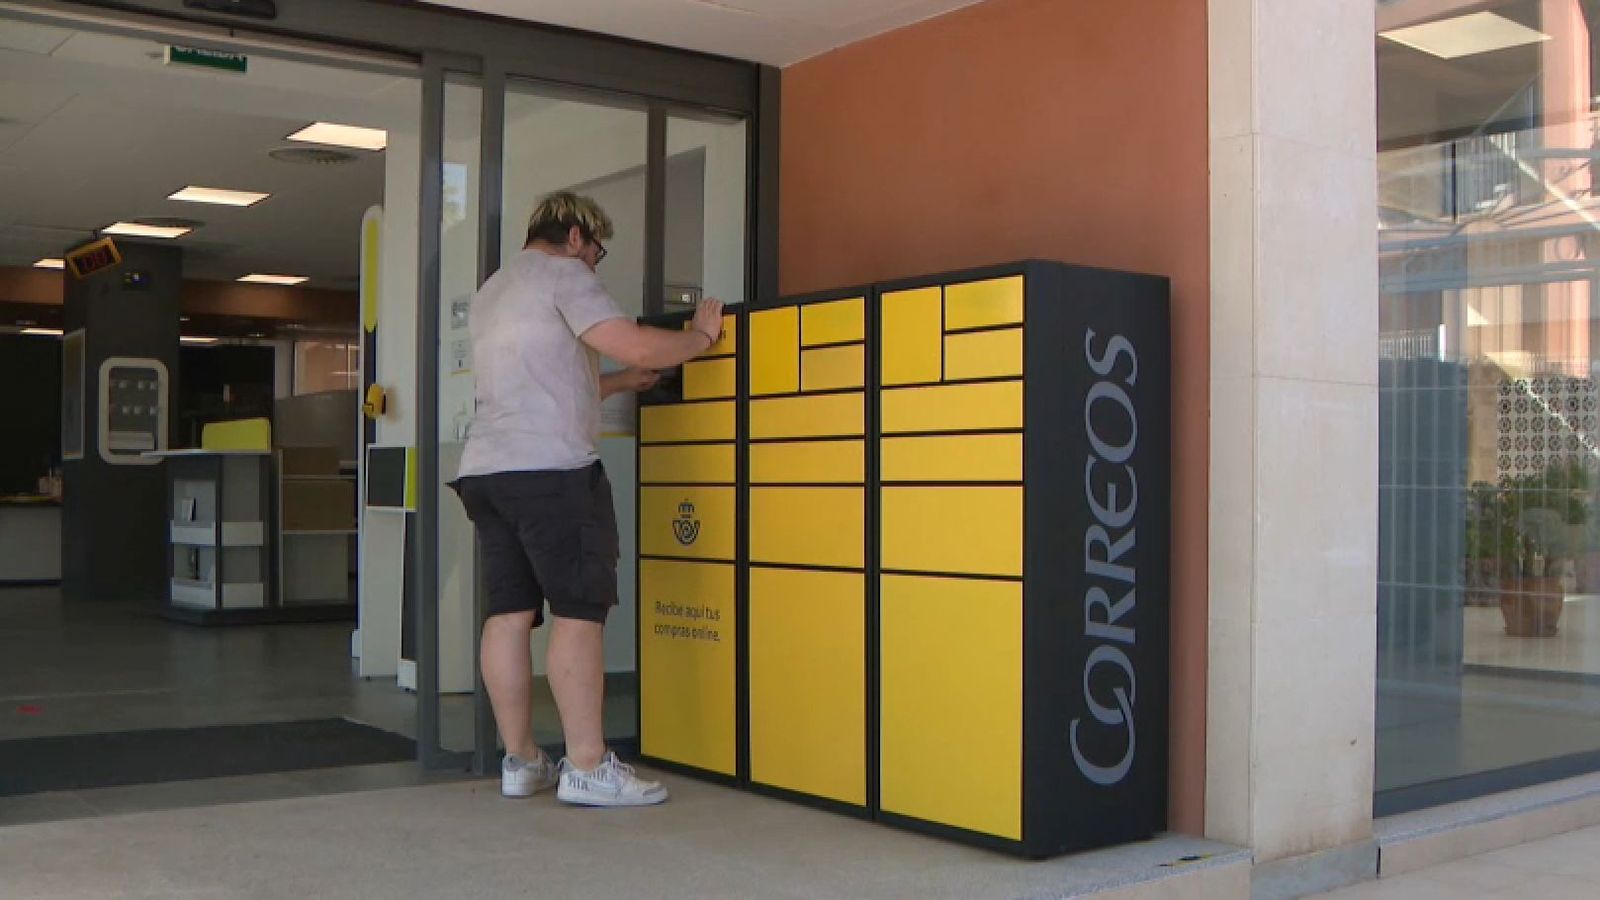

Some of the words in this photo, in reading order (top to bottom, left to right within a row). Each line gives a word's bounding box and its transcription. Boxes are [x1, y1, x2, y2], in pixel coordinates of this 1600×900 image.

[1069, 327, 1139, 786] CORREOS
[655, 600, 682, 616] Recibe
[705, 606, 721, 621] tus
[654, 624, 690, 640] compras
